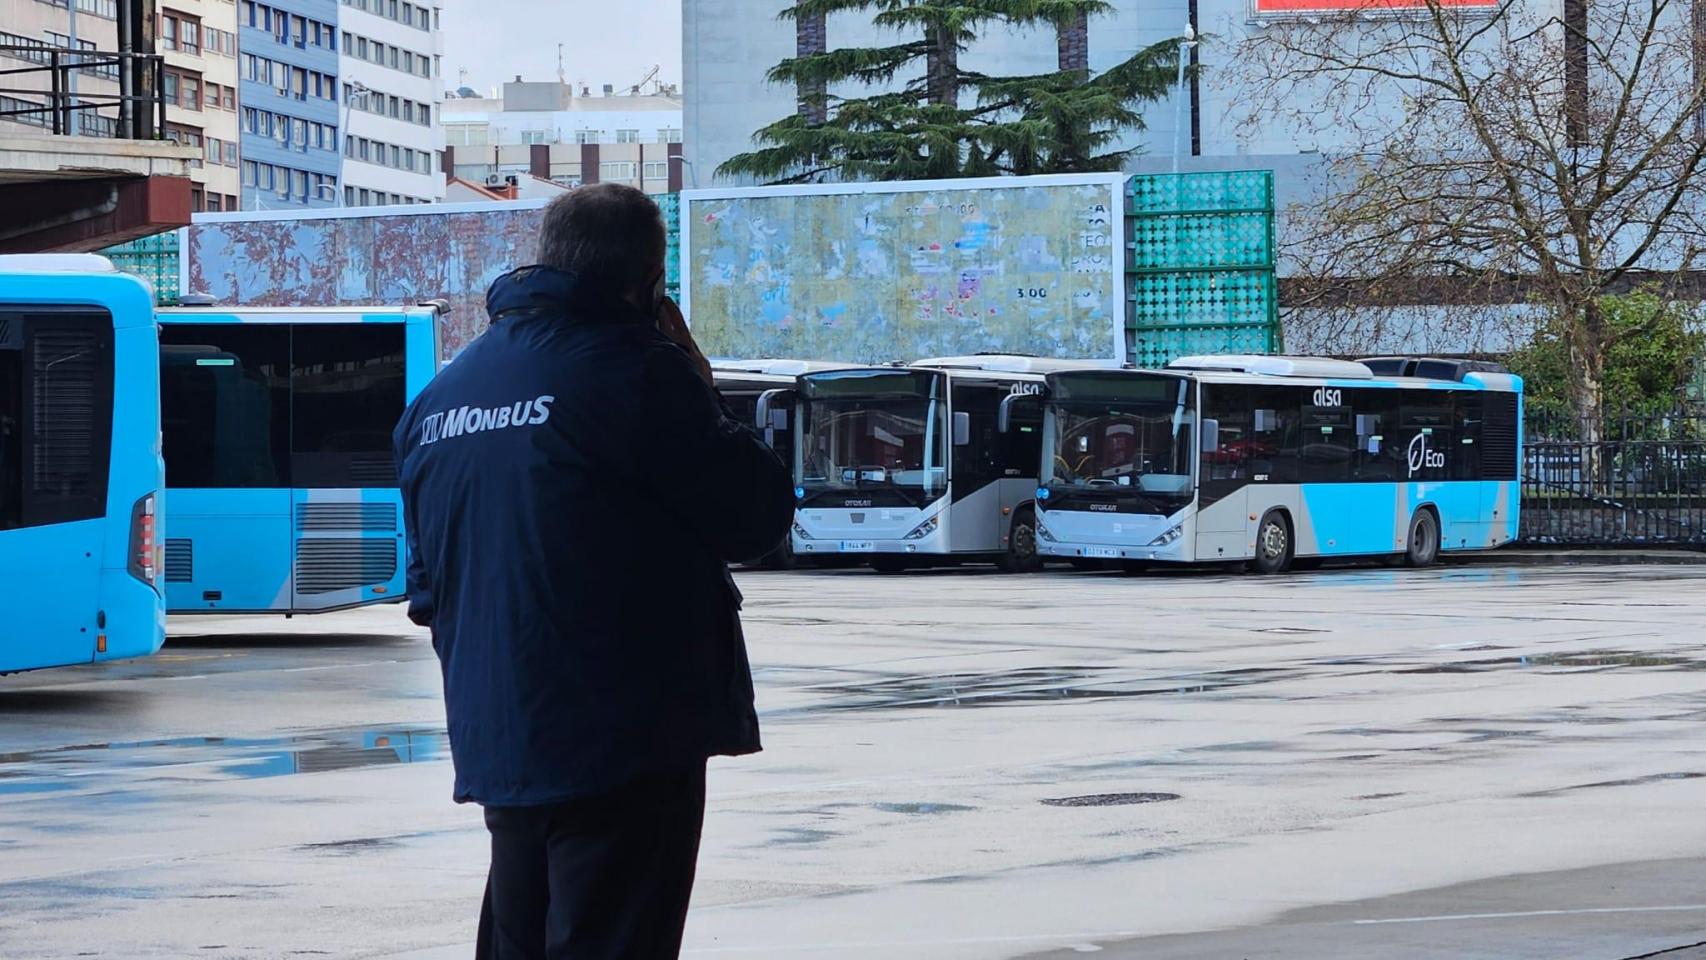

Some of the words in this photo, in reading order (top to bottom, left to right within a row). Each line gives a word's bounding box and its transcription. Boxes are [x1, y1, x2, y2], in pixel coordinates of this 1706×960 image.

[1313, 386, 1341, 407] alsa
[441, 395, 555, 439] MONBUS
[1425, 449, 1444, 468] Eco
